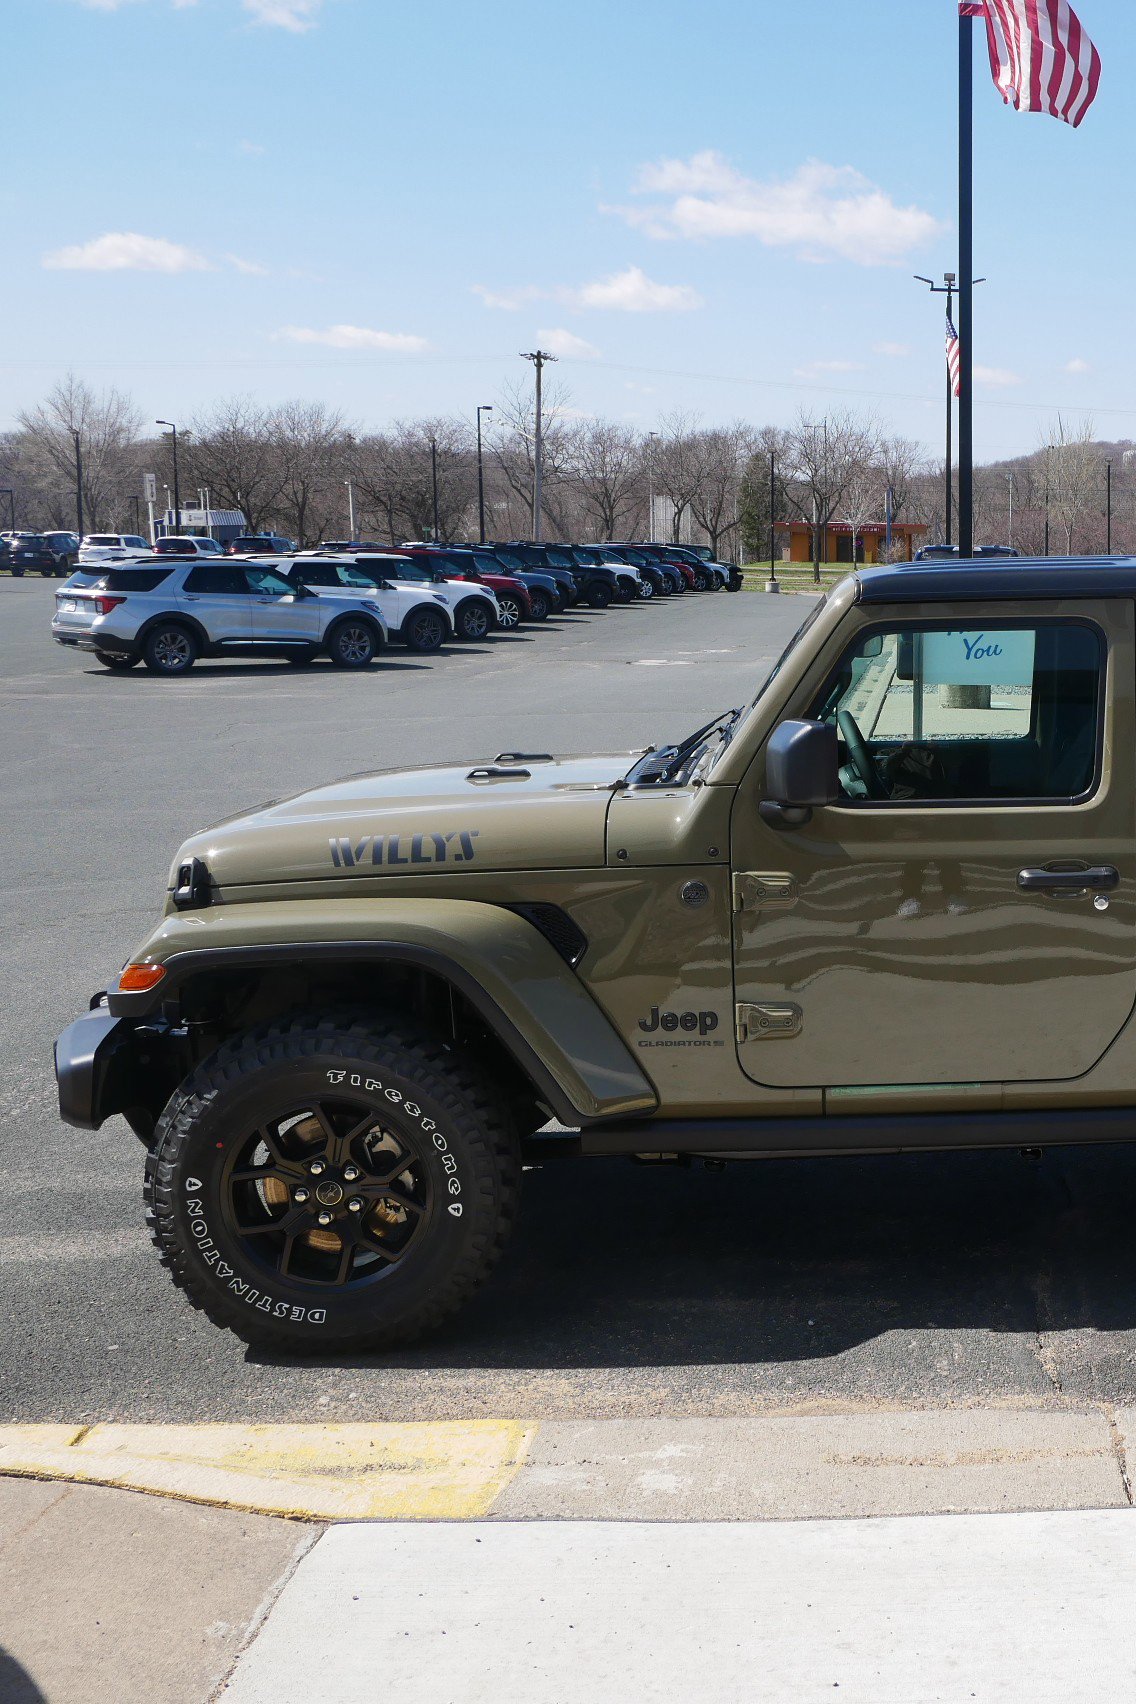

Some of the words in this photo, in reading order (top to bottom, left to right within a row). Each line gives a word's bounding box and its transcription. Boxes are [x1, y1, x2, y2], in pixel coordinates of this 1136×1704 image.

[962, 633, 1003, 660] You
[328, 830, 480, 868] WILLYS
[638, 1005, 719, 1035] Jeep
[186, 1198, 327, 1324] DESTINATION
